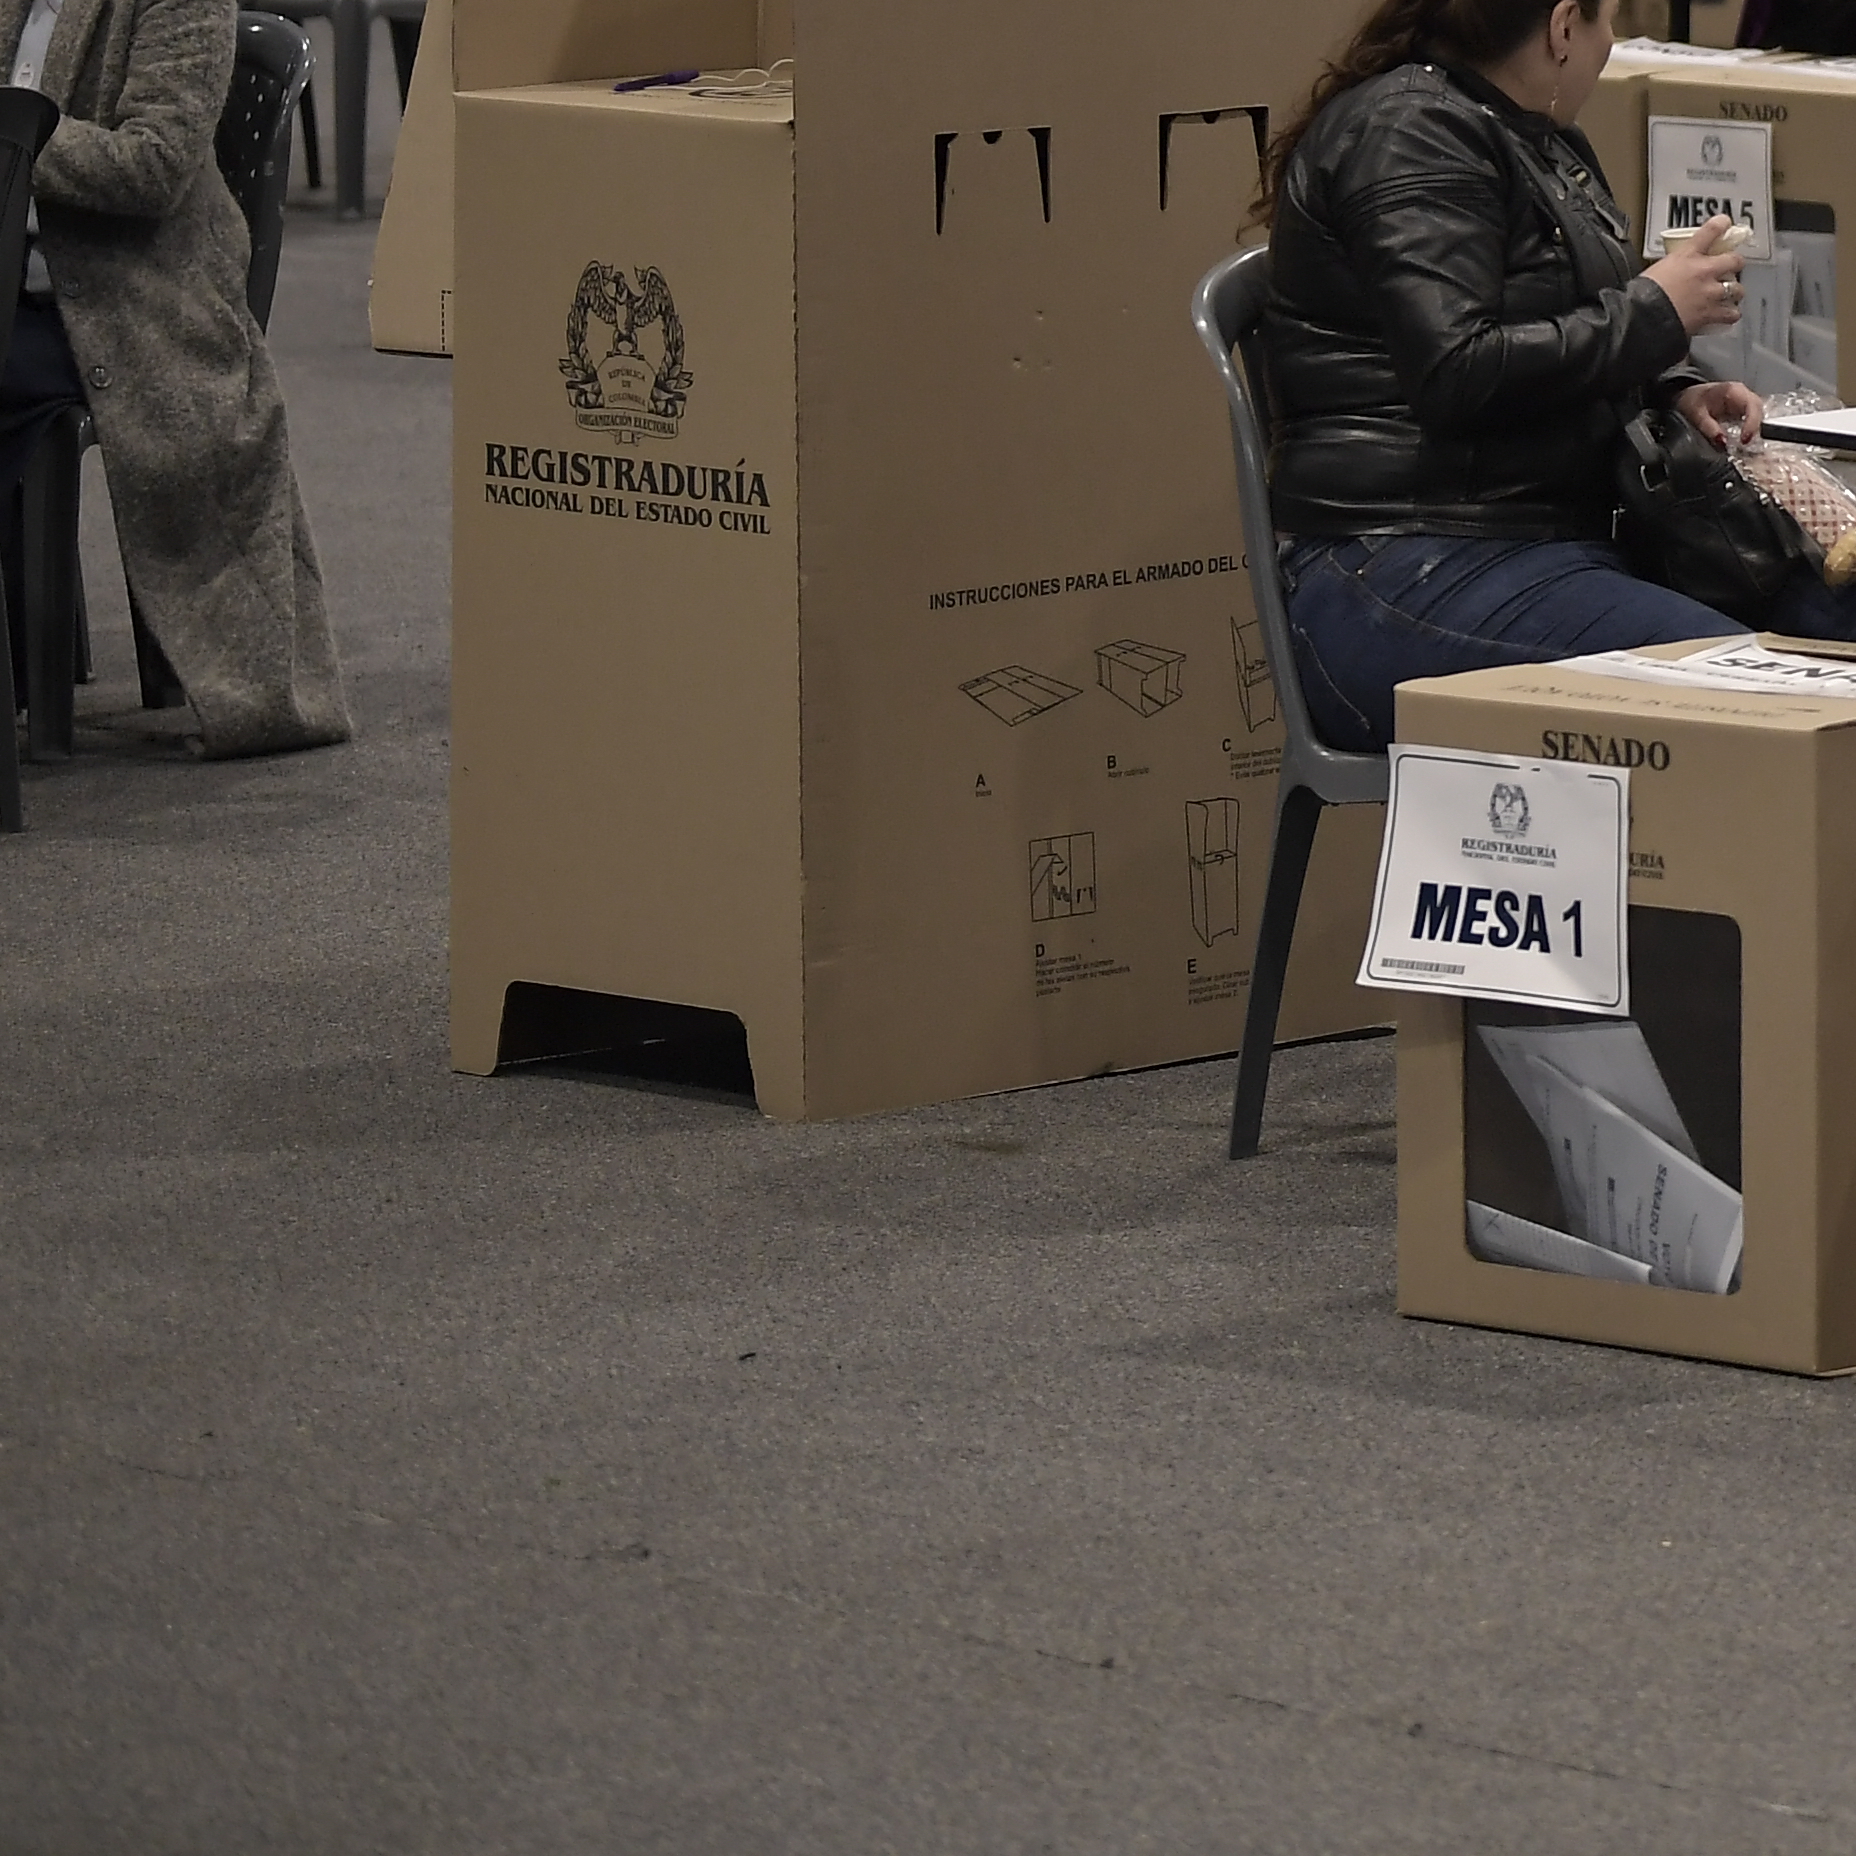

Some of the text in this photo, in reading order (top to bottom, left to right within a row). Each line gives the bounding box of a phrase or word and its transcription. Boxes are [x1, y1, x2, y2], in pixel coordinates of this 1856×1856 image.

[1719, 100, 1788, 122] SENADO
[607, 365, 647, 382] REPÚBLICA
[578, 411, 675, 435] ORGANIZACIÓN ELECTORAL
[485, 442, 771, 508] REGISTRADURÍA
[485, 483, 771, 535] NACIONAL DEL ESTADO CIVIL
[929, 578, 1061, 610] INSTRUCCIONES
[1065, 572, 1108, 593] PARA
[1112, 568, 1132, 586] EL
[1135, 559, 1204, 584] ARMADO
[1208, 555, 1238, 574] DEL
[1222, 738, 1233, 752] C
[1541, 729, 1671, 772] SENADO
[1107, 755, 1117, 769] B
[975, 774, 986, 787] A
[1461, 837, 1557, 860] REGISTRADURÍA
[1411, 882, 1583, 959] MESA 1
[1035, 944, 1045, 957] D
[1187, 959, 1197, 973] E
